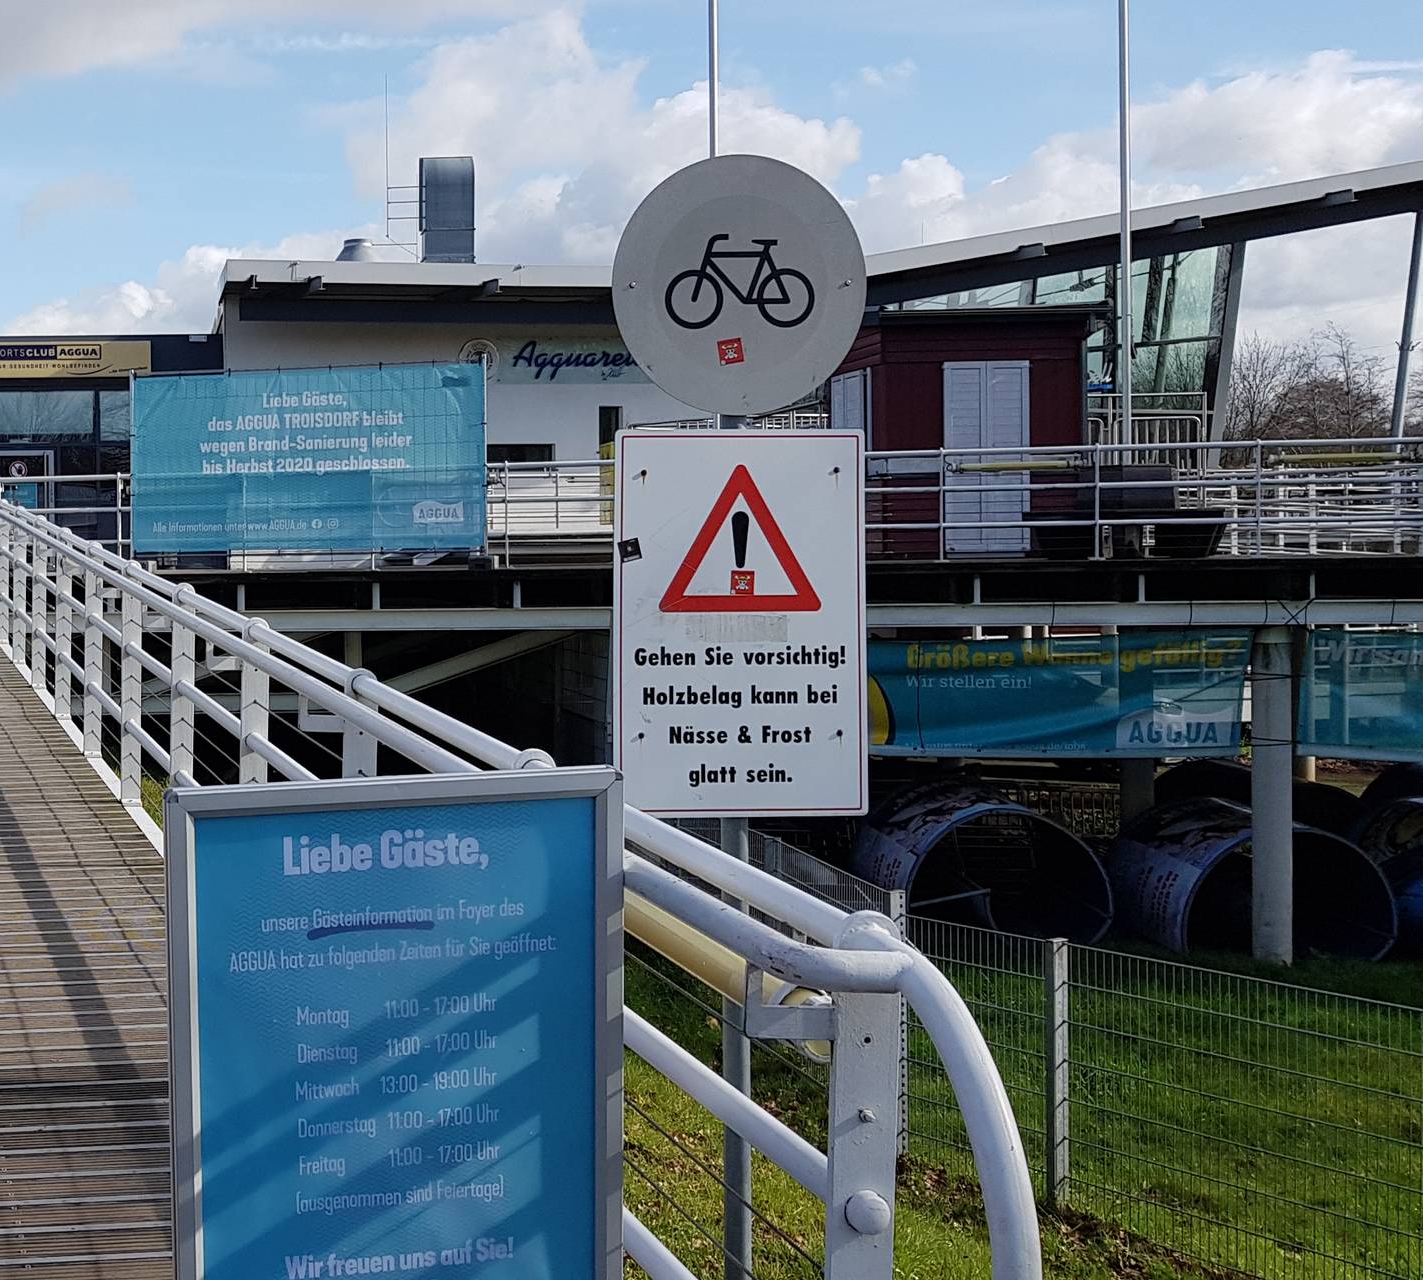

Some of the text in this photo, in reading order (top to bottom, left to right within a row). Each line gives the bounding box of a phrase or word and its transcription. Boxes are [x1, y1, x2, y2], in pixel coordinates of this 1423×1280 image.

[59, 347, 98, 357] AGGUA
[262, 390, 347, 409] Liebe Gäste,
[208, 410, 404, 432] das AGGUA TROISDORF bleibt
[199, 432, 412, 457] wegen Brand-Sanierung leider
[202, 455, 409, 475] bis Herbst 2020 geschlossen.
[152, 521, 167, 533] Alle
[168, 519, 223, 533] Informationen
[224, 520, 246, 532] unter
[417, 507, 460, 520] AGGUA
[634, 645, 846, 669] Gehen Sie vorsichtig!
[907, 644, 1015, 669] Größere
[906, 675, 1032, 689] Wir stellen ein!
[642, 684, 838, 709] Holzbelag kann bei
[669, 725, 812, 744] Nässe & Frost
[1128, 720, 1217, 744] AGGUA
[689, 763, 793, 787] glatt sein.
[283, 829, 489, 876] Liebe Gäste,
[261, 898, 524, 932] unsere Gästeinformation im Foyer des
[230, 932, 556, 973] AGGUA hat zu folgenden Zeiten für Sie geöffnet:
[296, 1006, 350, 1029] Montag
[385, 999, 419, 1019] 11:00
[434, 995, 470, 1015] 17:00
[473, 992, 497, 1012] Uhr
[297, 1043, 358, 1065] Dienstag
[385, 1036, 420, 1057] 11:00
[434, 1032, 470, 1052] 17:00
[474, 1029, 498, 1049] Uhr
[295, 1077, 359, 1101] Mittwoch
[379, 1074, 418, 1094] 13:00
[433, 1069, 470, 1090] 19:00
[473, 1066, 497, 1086] Uhr
[297, 1117, 376, 1138] Donnerstag
[387, 1110, 423, 1130] 11:00
[438, 1107, 473, 1126] 17:00
[476, 1103, 500, 1123] Uhr
[299, 1155, 345, 1177] Freitag
[388, 1147, 422, 1167] 11:00
[438, 1143, 473, 1163] 17:00
[477, 1140, 500, 1160] Uhr
[296, 1174, 504, 1216] (ausgenommen sind Feiertage)
[285, 1237, 514, 1280] Wir freuen uns auf Sie!
